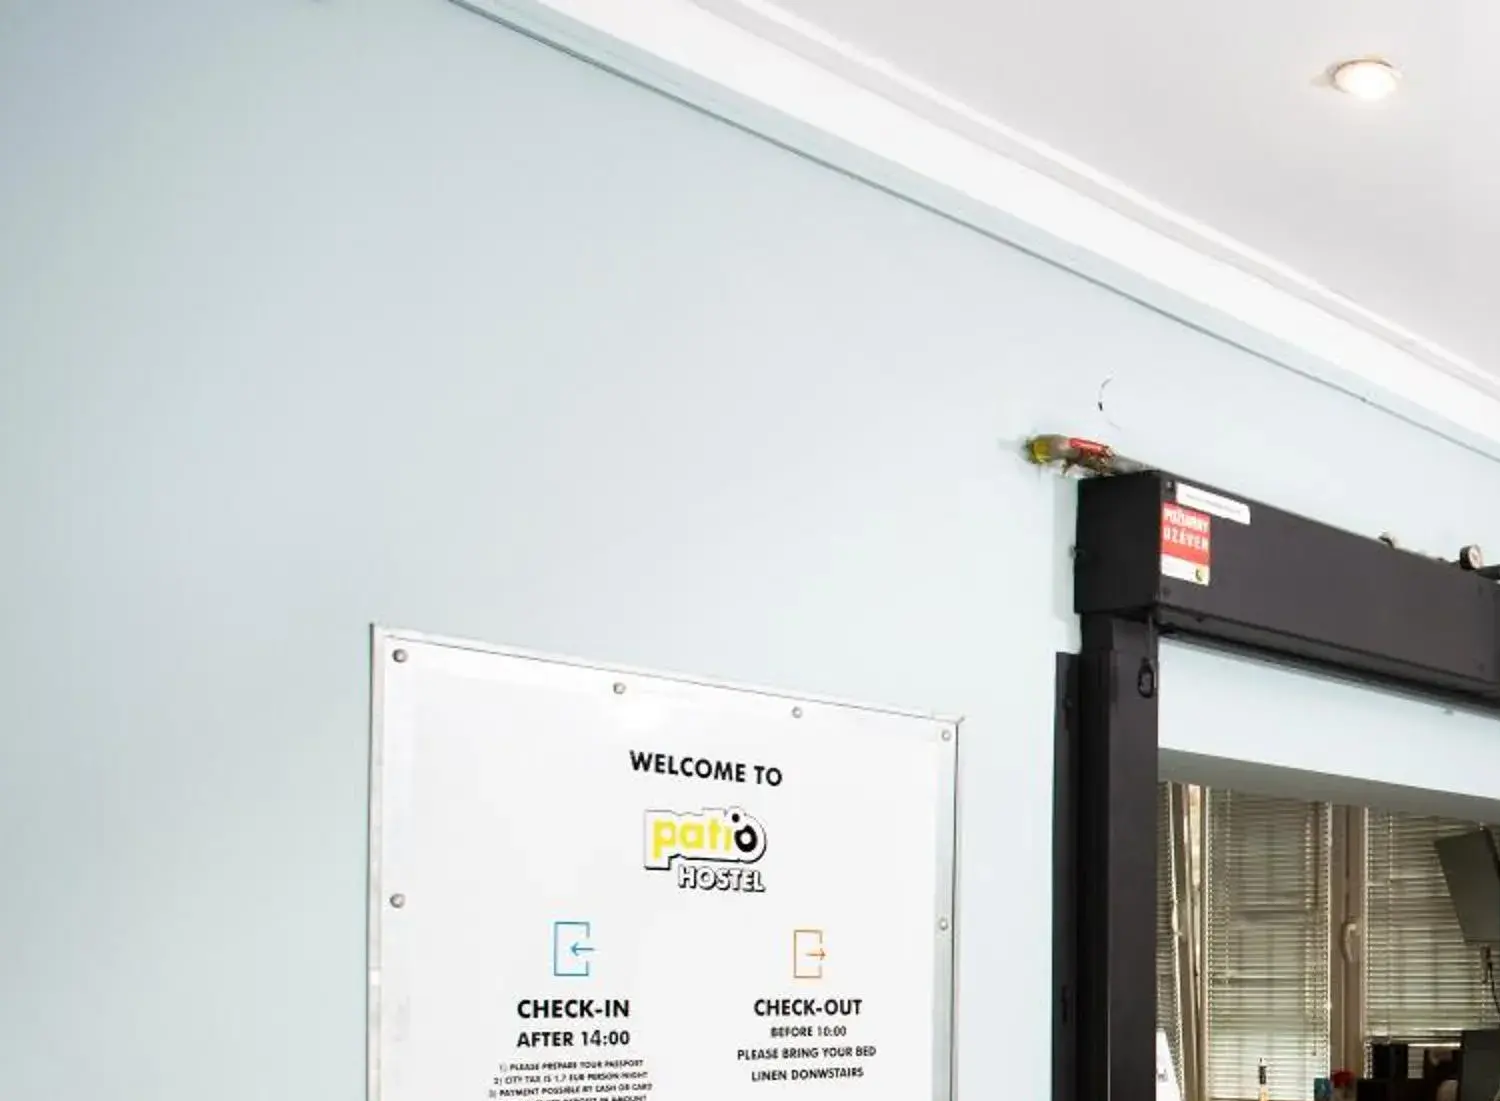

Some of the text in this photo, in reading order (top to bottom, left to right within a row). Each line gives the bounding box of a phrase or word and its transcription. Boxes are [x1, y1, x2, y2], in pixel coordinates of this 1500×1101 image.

[629, 749, 782, 786] WELCOME TO
[653, 812, 758, 861] patio
[678, 864, 766, 893] HOSTEL
[517, 999, 630, 1018] CHECK-IN
[753, 998, 863, 1016] CHECK-OUT
[517, 1029, 630, 1047] AFTER 14:00
[770, 1026, 813, 1037] BEFORE
[737, 1045, 877, 1061] PLEASE BRING YOUR BED
[751, 1067, 864, 1082] LINEN DONWSTAIRS
[499, 1088, 539, 1096] PAYMENT
[542, 1086, 580, 1094] POSSIBLE
